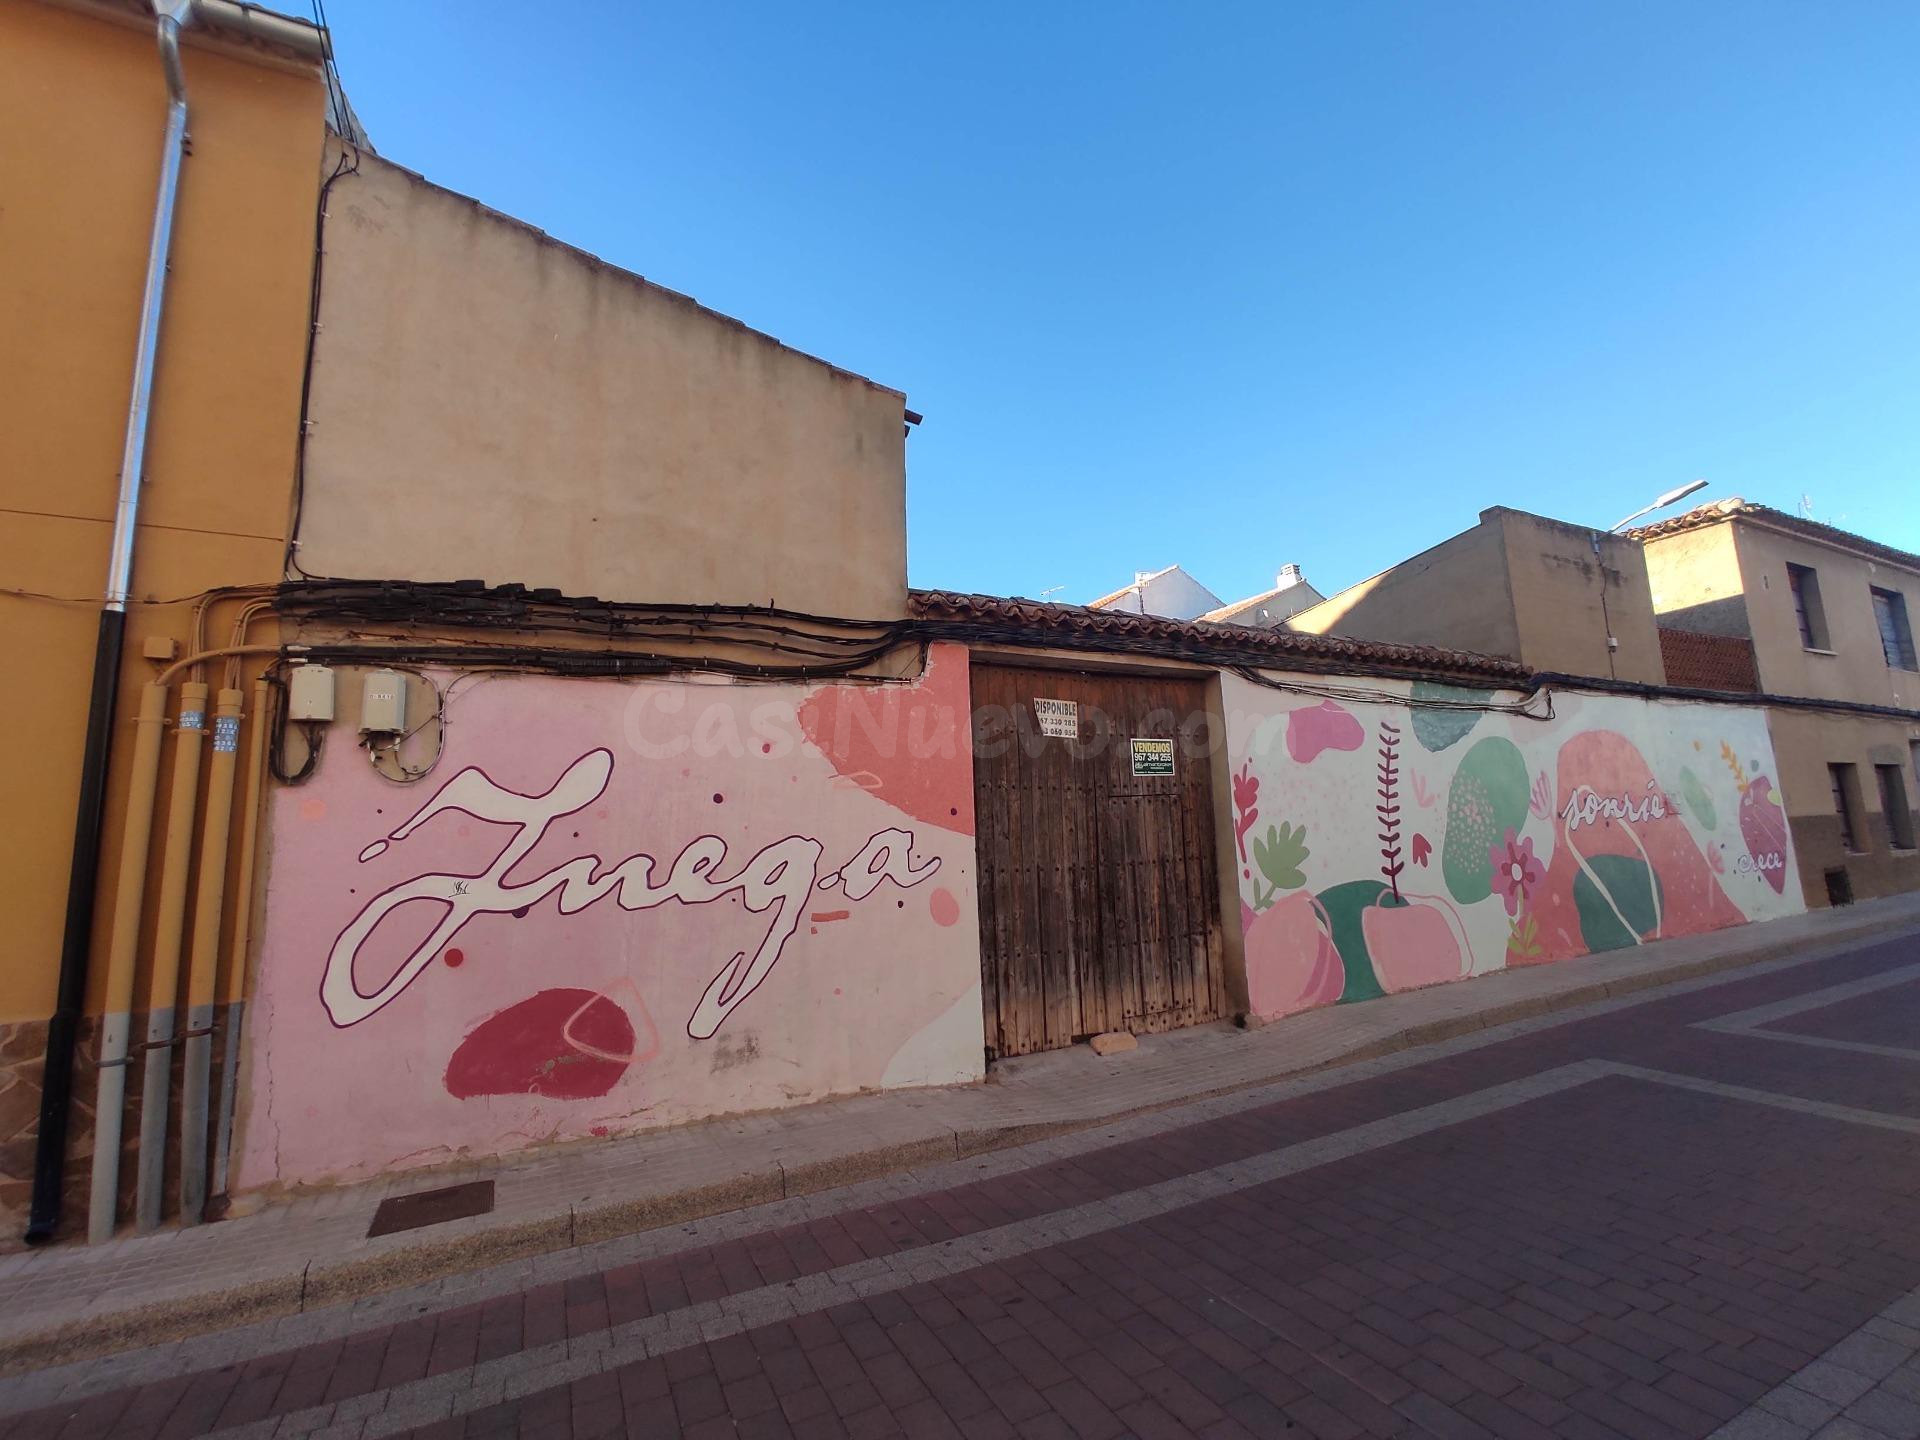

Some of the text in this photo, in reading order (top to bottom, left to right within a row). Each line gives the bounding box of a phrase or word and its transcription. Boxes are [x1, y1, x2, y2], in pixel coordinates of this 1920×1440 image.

[1035, 700, 1076, 716] DISPONIBLE
[1134, 742, 1171, 753] VENDEMOS
[1147, 753, 1159, 762] 344
